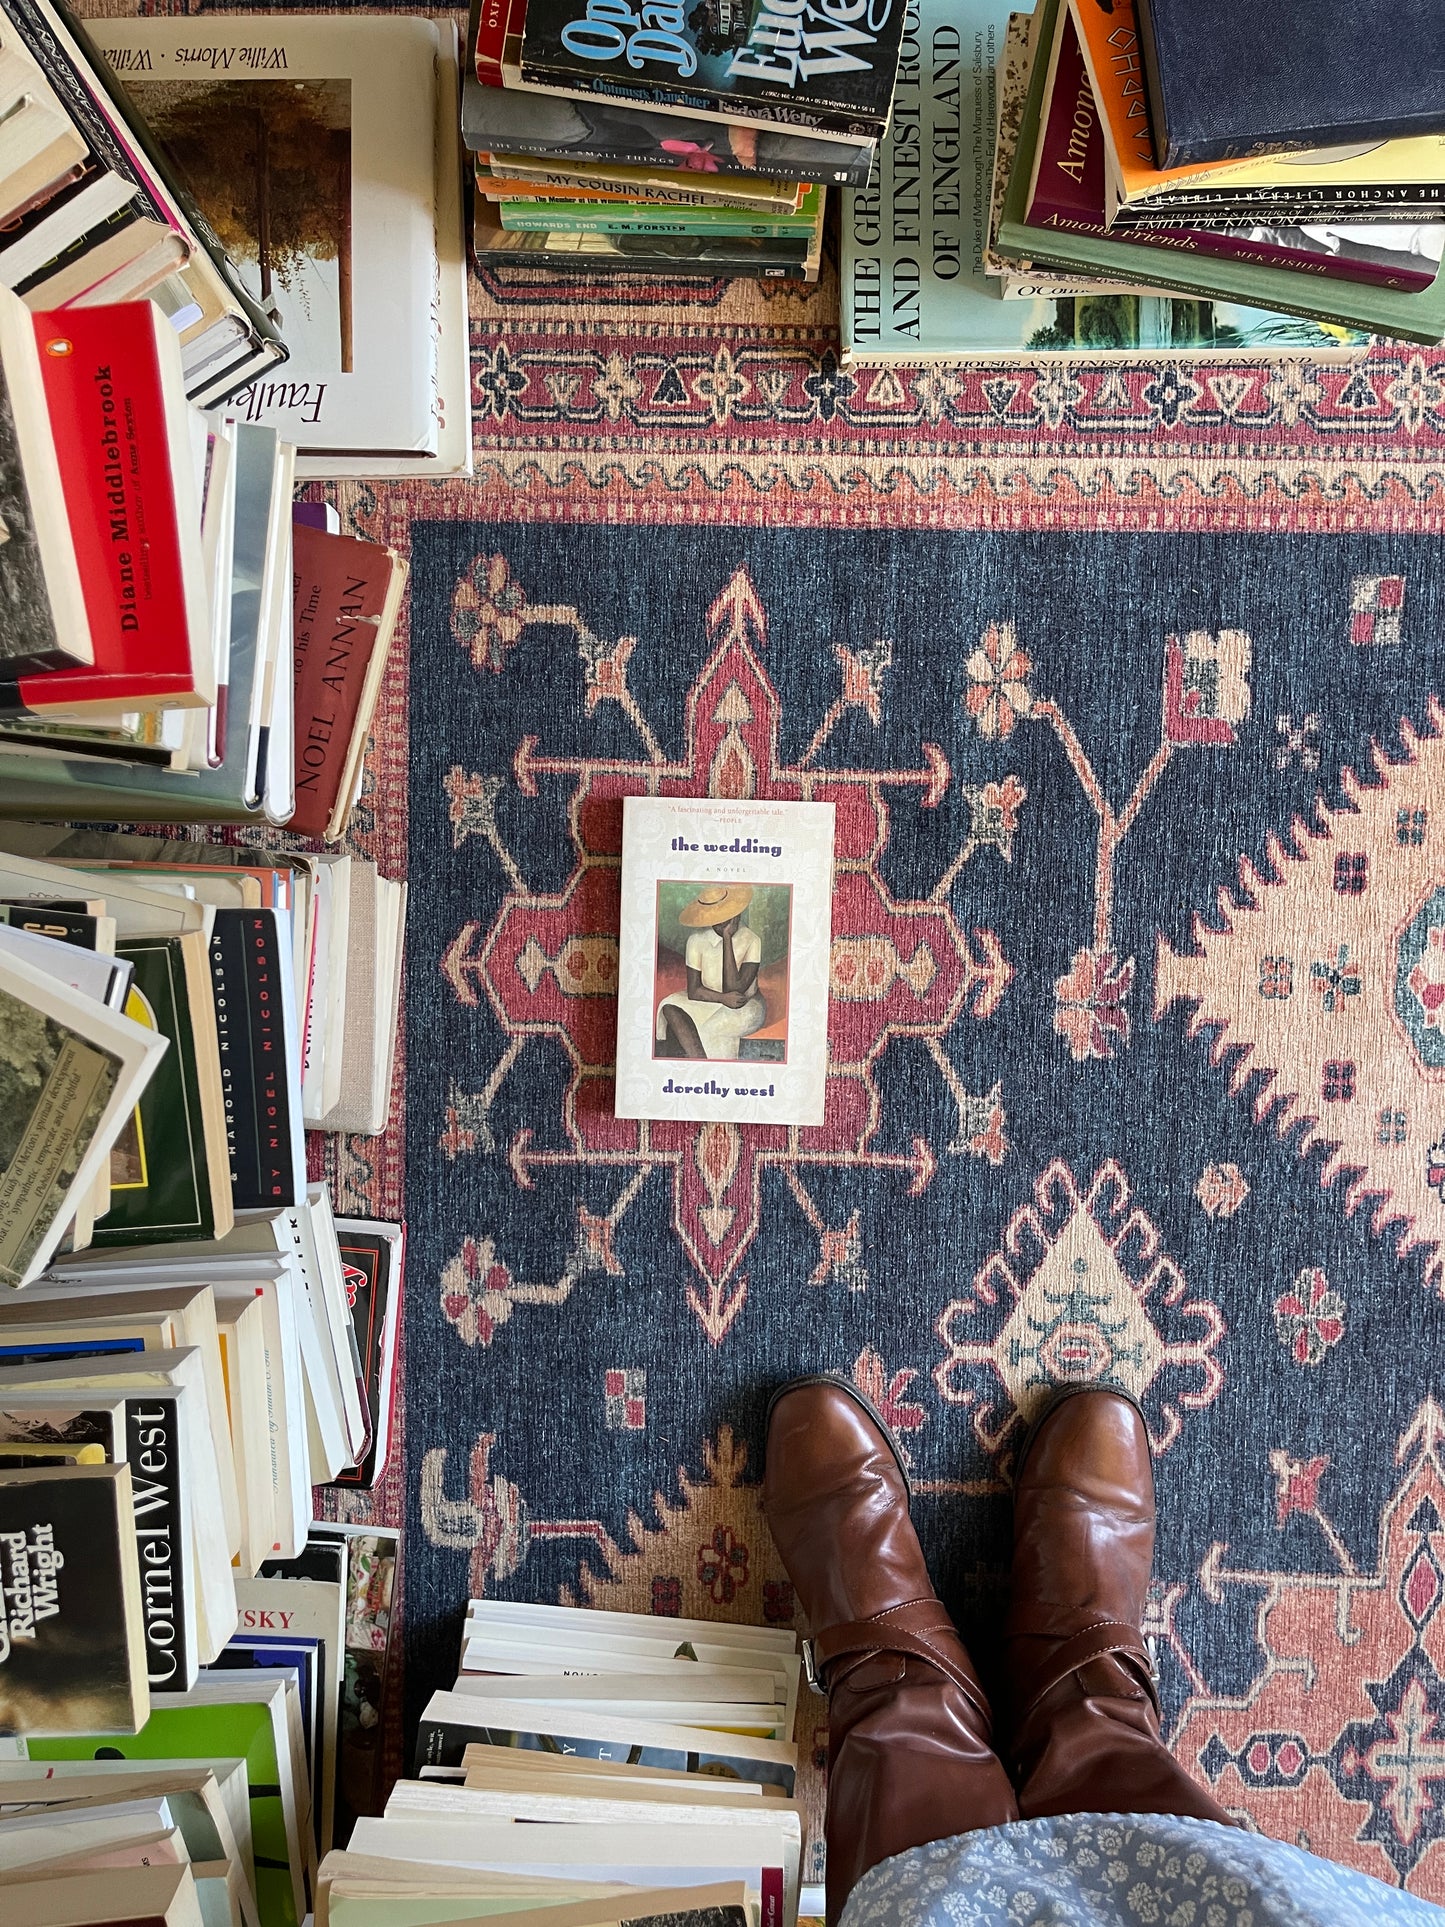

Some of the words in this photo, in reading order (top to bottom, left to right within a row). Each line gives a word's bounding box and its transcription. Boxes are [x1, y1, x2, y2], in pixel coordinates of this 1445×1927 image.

[985, 23, 995, 53] others
[175, 47, 236, 69] Morris
[239, 47, 288, 69] Willie
[985, 56, 995, 73] and
[972, 75, 982, 85] of
[718, 99, 773, 121] Eudora
[773, 107, 824, 127] Welty
[828, 99, 850, 108] CANADA
[972, 87, 984, 134] Marquess
[985, 75, 995, 125] Harewood
[933, 26, 960, 220] ENGLAND
[985, 126, 995, 136] of
[577, 151, 618, 160] SMALL
[626, 155, 675, 164] THINGS
[972, 136, 982, 151] The
[985, 138, 995, 156] Earl
[726, 164, 795, 176] ARUNDHATI
[800, 170, 822, 178] ROY
[893, 100, 920, 246] FINEST
[547, 175, 571, 186] MY
[578, 177, 640, 196] COUSIN
[646, 188, 708, 205] RACHEL
[1235, 190, 1323, 201] LITERARY
[1335, 189, 1407, 199] ANCHOR
[517, 221, 571, 229] HOWARDS
[576, 222, 597, 230] END
[637, 224, 686, 232] FORSTER
[972, 218, 982, 227] of
[1134, 218, 1187, 230] EMILY
[1192, 215, 1298, 228] DICKINSON
[933, 230, 960, 280] OF
[972, 229, 982, 253] Duke
[1042, 213, 1115, 237] Among
[1121, 229, 1199, 249] Friends
[1271, 256, 1328, 273] FISHER
[972, 256, 982, 274] The
[854, 258, 881, 344] THE
[893, 257, 920, 341] AND
[1033, 255, 1087, 269] ENCYCLOPEDIA
[1101, 268, 1145, 281] GARDENING
[1163, 281, 1199, 292] COLORED
[1200, 289, 1238, 300] CHILDREN
[1247, 299, 1278, 309] JAMAICA
[1280, 306, 1312, 316] KINCAID
[1321, 314, 1341, 322] KARA
[1344, 320, 1374, 330] WALKER
[956, 360, 1021, 368] HOUSES
[1134, 359, 1195, 367] ROOMS
[1198, 358, 1223, 366] OF
[1226, 357, 1313, 365] ENGLAND
[123, 397, 136, 442] Sexton
[94, 365, 129, 543] Middlebrook
[127, 441, 138, 477] Anne
[128, 479, 139, 495] of
[131, 496, 145, 534] author
[118, 551, 139, 632] Diane
[299, 585, 322, 623] Time
[294, 631, 310, 652] his
[296, 713, 335, 793] NOEL
[321, 576, 368, 694] ANNAN
[678, 805, 712, 815] fascinating
[728, 808, 769, 816] unforgettable
[671, 836, 700, 852] the
[704, 838, 782, 857] wedding
[213, 936, 230, 1051] NICOLSON
[254, 919, 273, 1051] NICOLSON
[46, 1049, 78, 1099] development
[662, 1078, 730, 1098] dorothy
[734, 1084, 775, 1097] west
[32, 1099, 57, 1132] spiritual
[223, 1067, 236, 1155] HAROLD
[266, 1071, 279, 1148] NIGEL
[16, 1131, 40, 1165] Merton's
[33, 1127, 60, 1166] temperate
[50, 1110, 65, 1126] and
[12, 1165, 24, 1175] of
[231, 1172, 238, 1182] &
[271, 1168, 282, 1195] BY
[0, 1175, 21, 1199] study
[131, 1406, 170, 1517] West
[1, 1531, 36, 1638] Richard
[26, 1523, 64, 1621] Wright
[136, 1525, 178, 1683] Cornel
